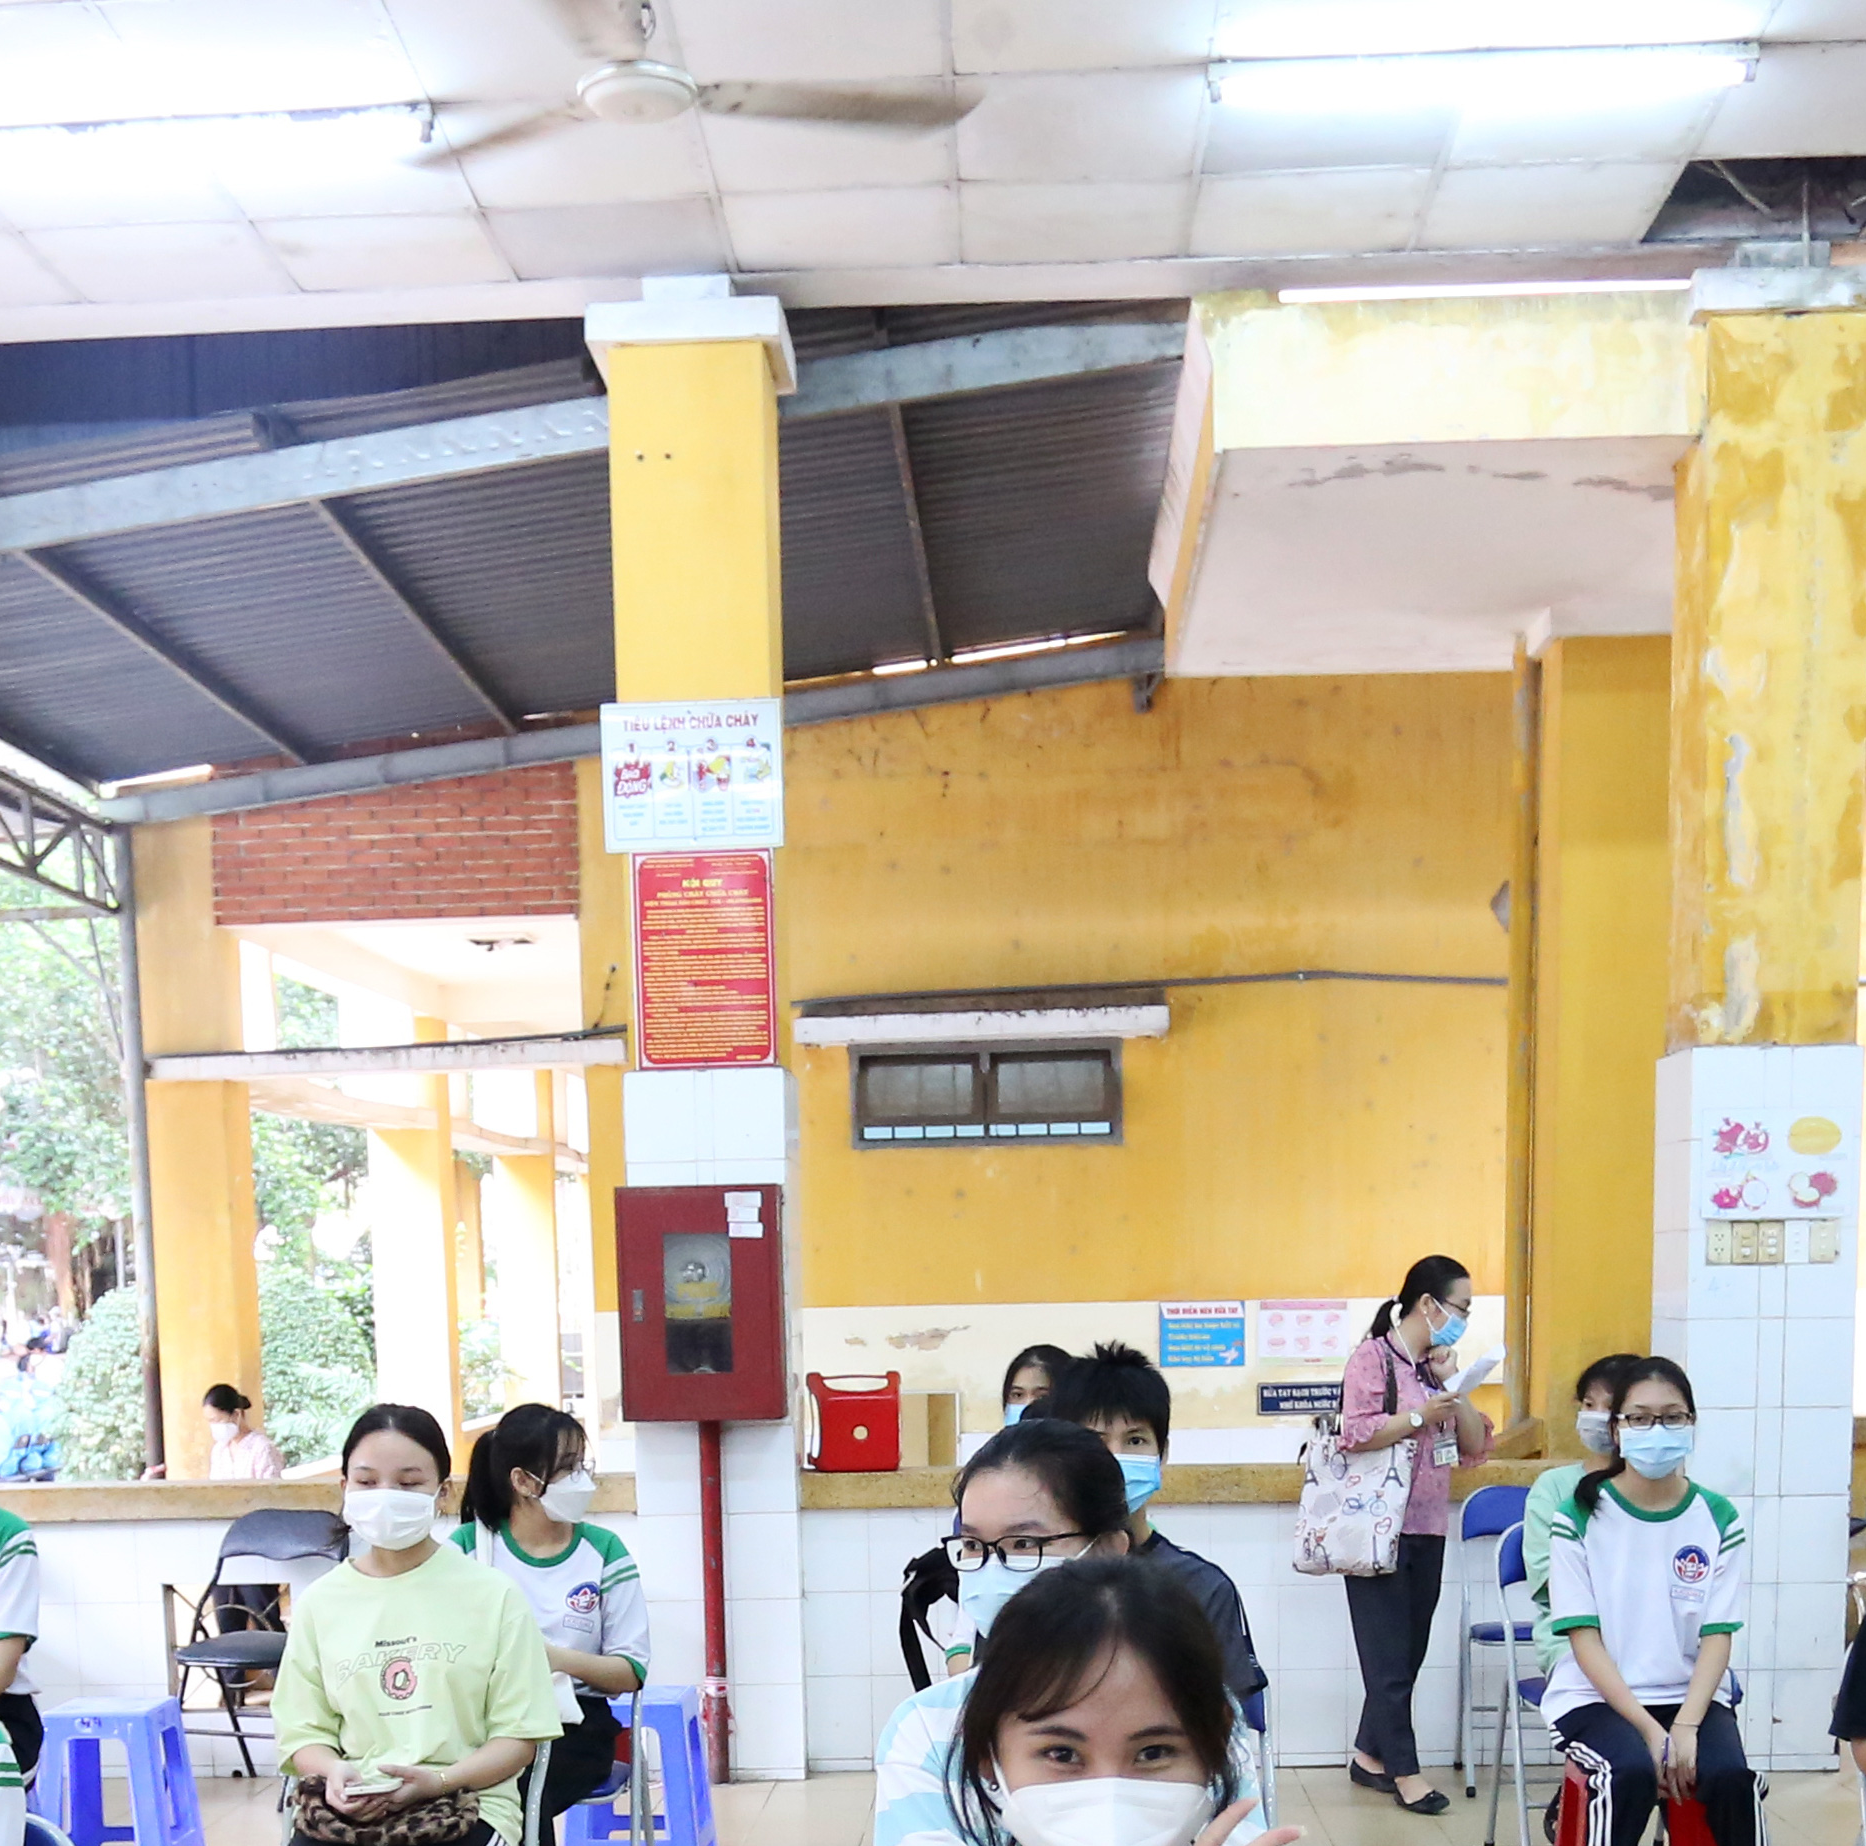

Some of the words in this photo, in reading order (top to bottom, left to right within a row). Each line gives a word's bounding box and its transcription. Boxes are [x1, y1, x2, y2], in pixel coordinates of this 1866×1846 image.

[667, 741, 675, 751] 2
[706, 739, 718, 751] 3
[746, 738, 756, 748] 4
[335, 1642, 467, 1690] BAKERY
